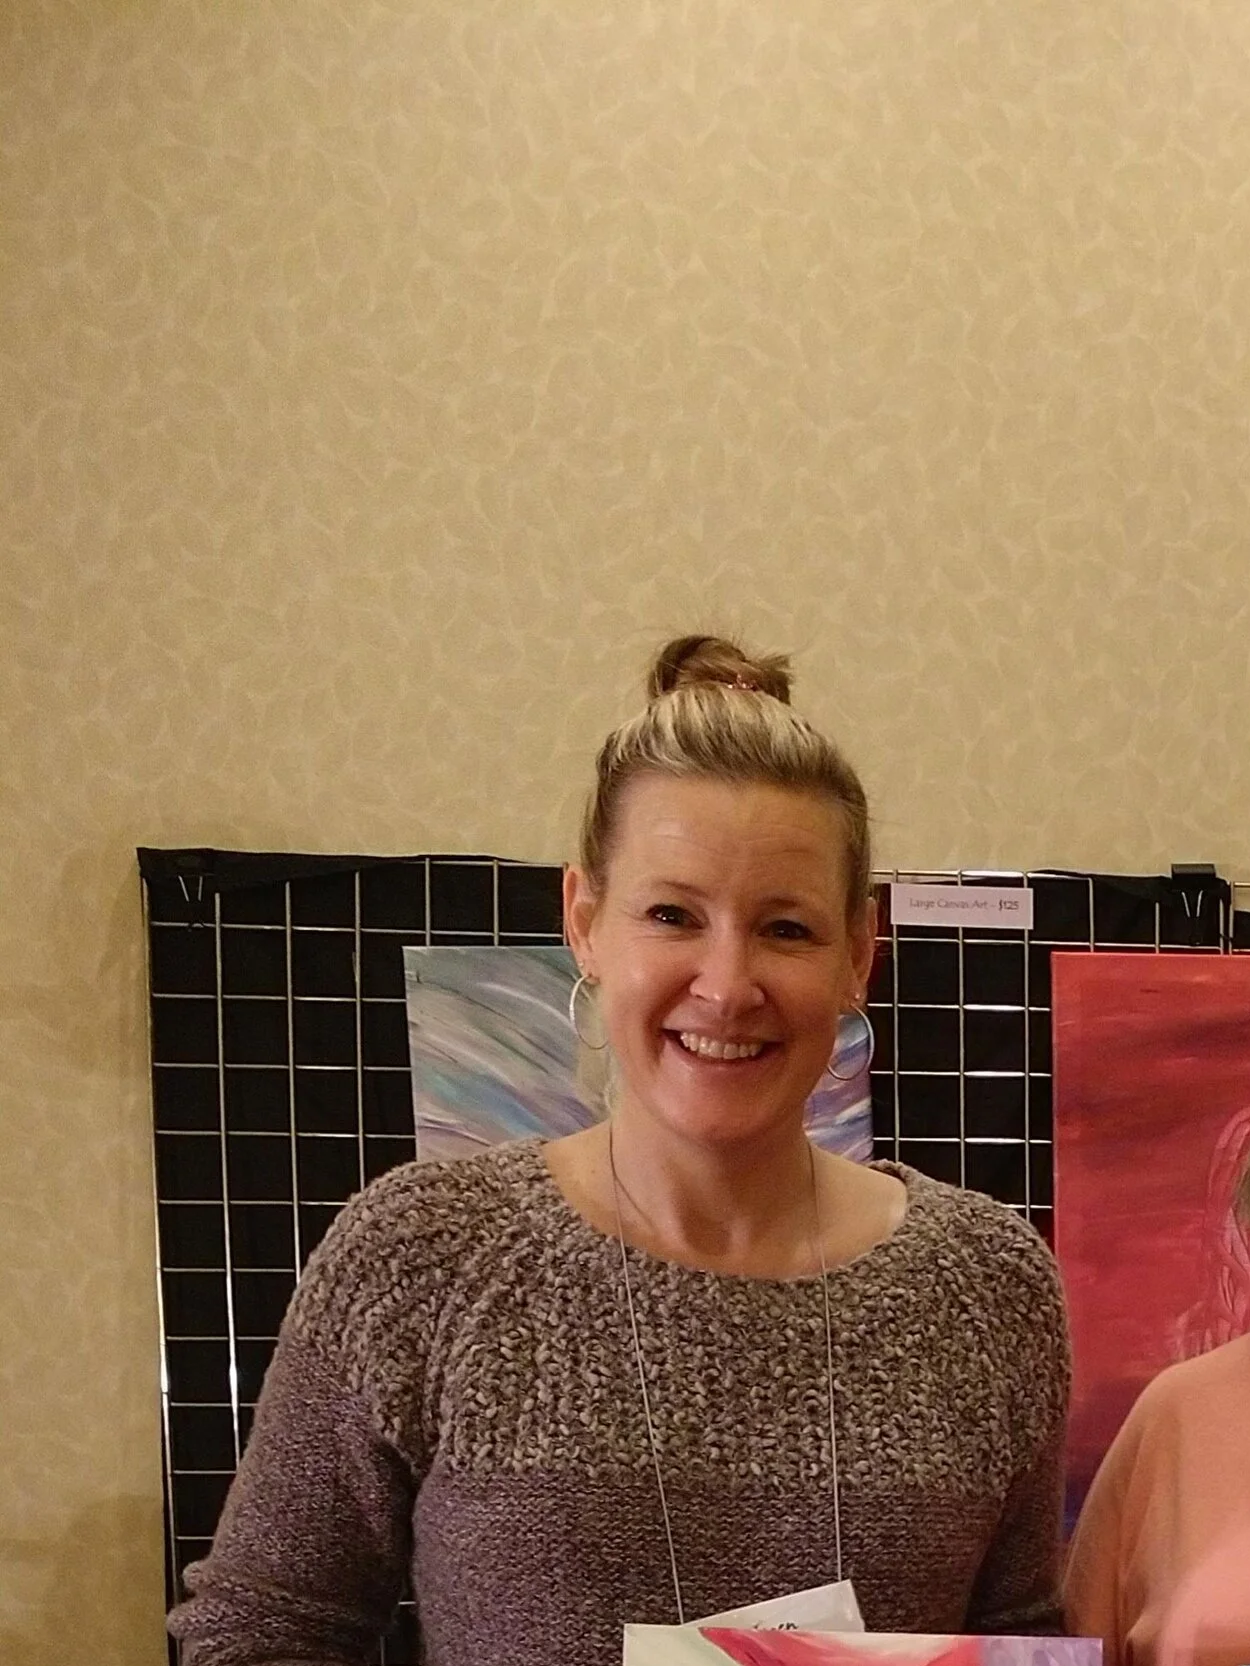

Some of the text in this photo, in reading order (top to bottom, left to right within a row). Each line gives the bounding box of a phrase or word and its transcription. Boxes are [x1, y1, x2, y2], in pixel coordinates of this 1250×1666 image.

[909, 898, 934, 910] Large
[937, 898, 969, 909] Canvas
[972, 899, 988, 909] Art
[998, 899, 1020, 911] $125
